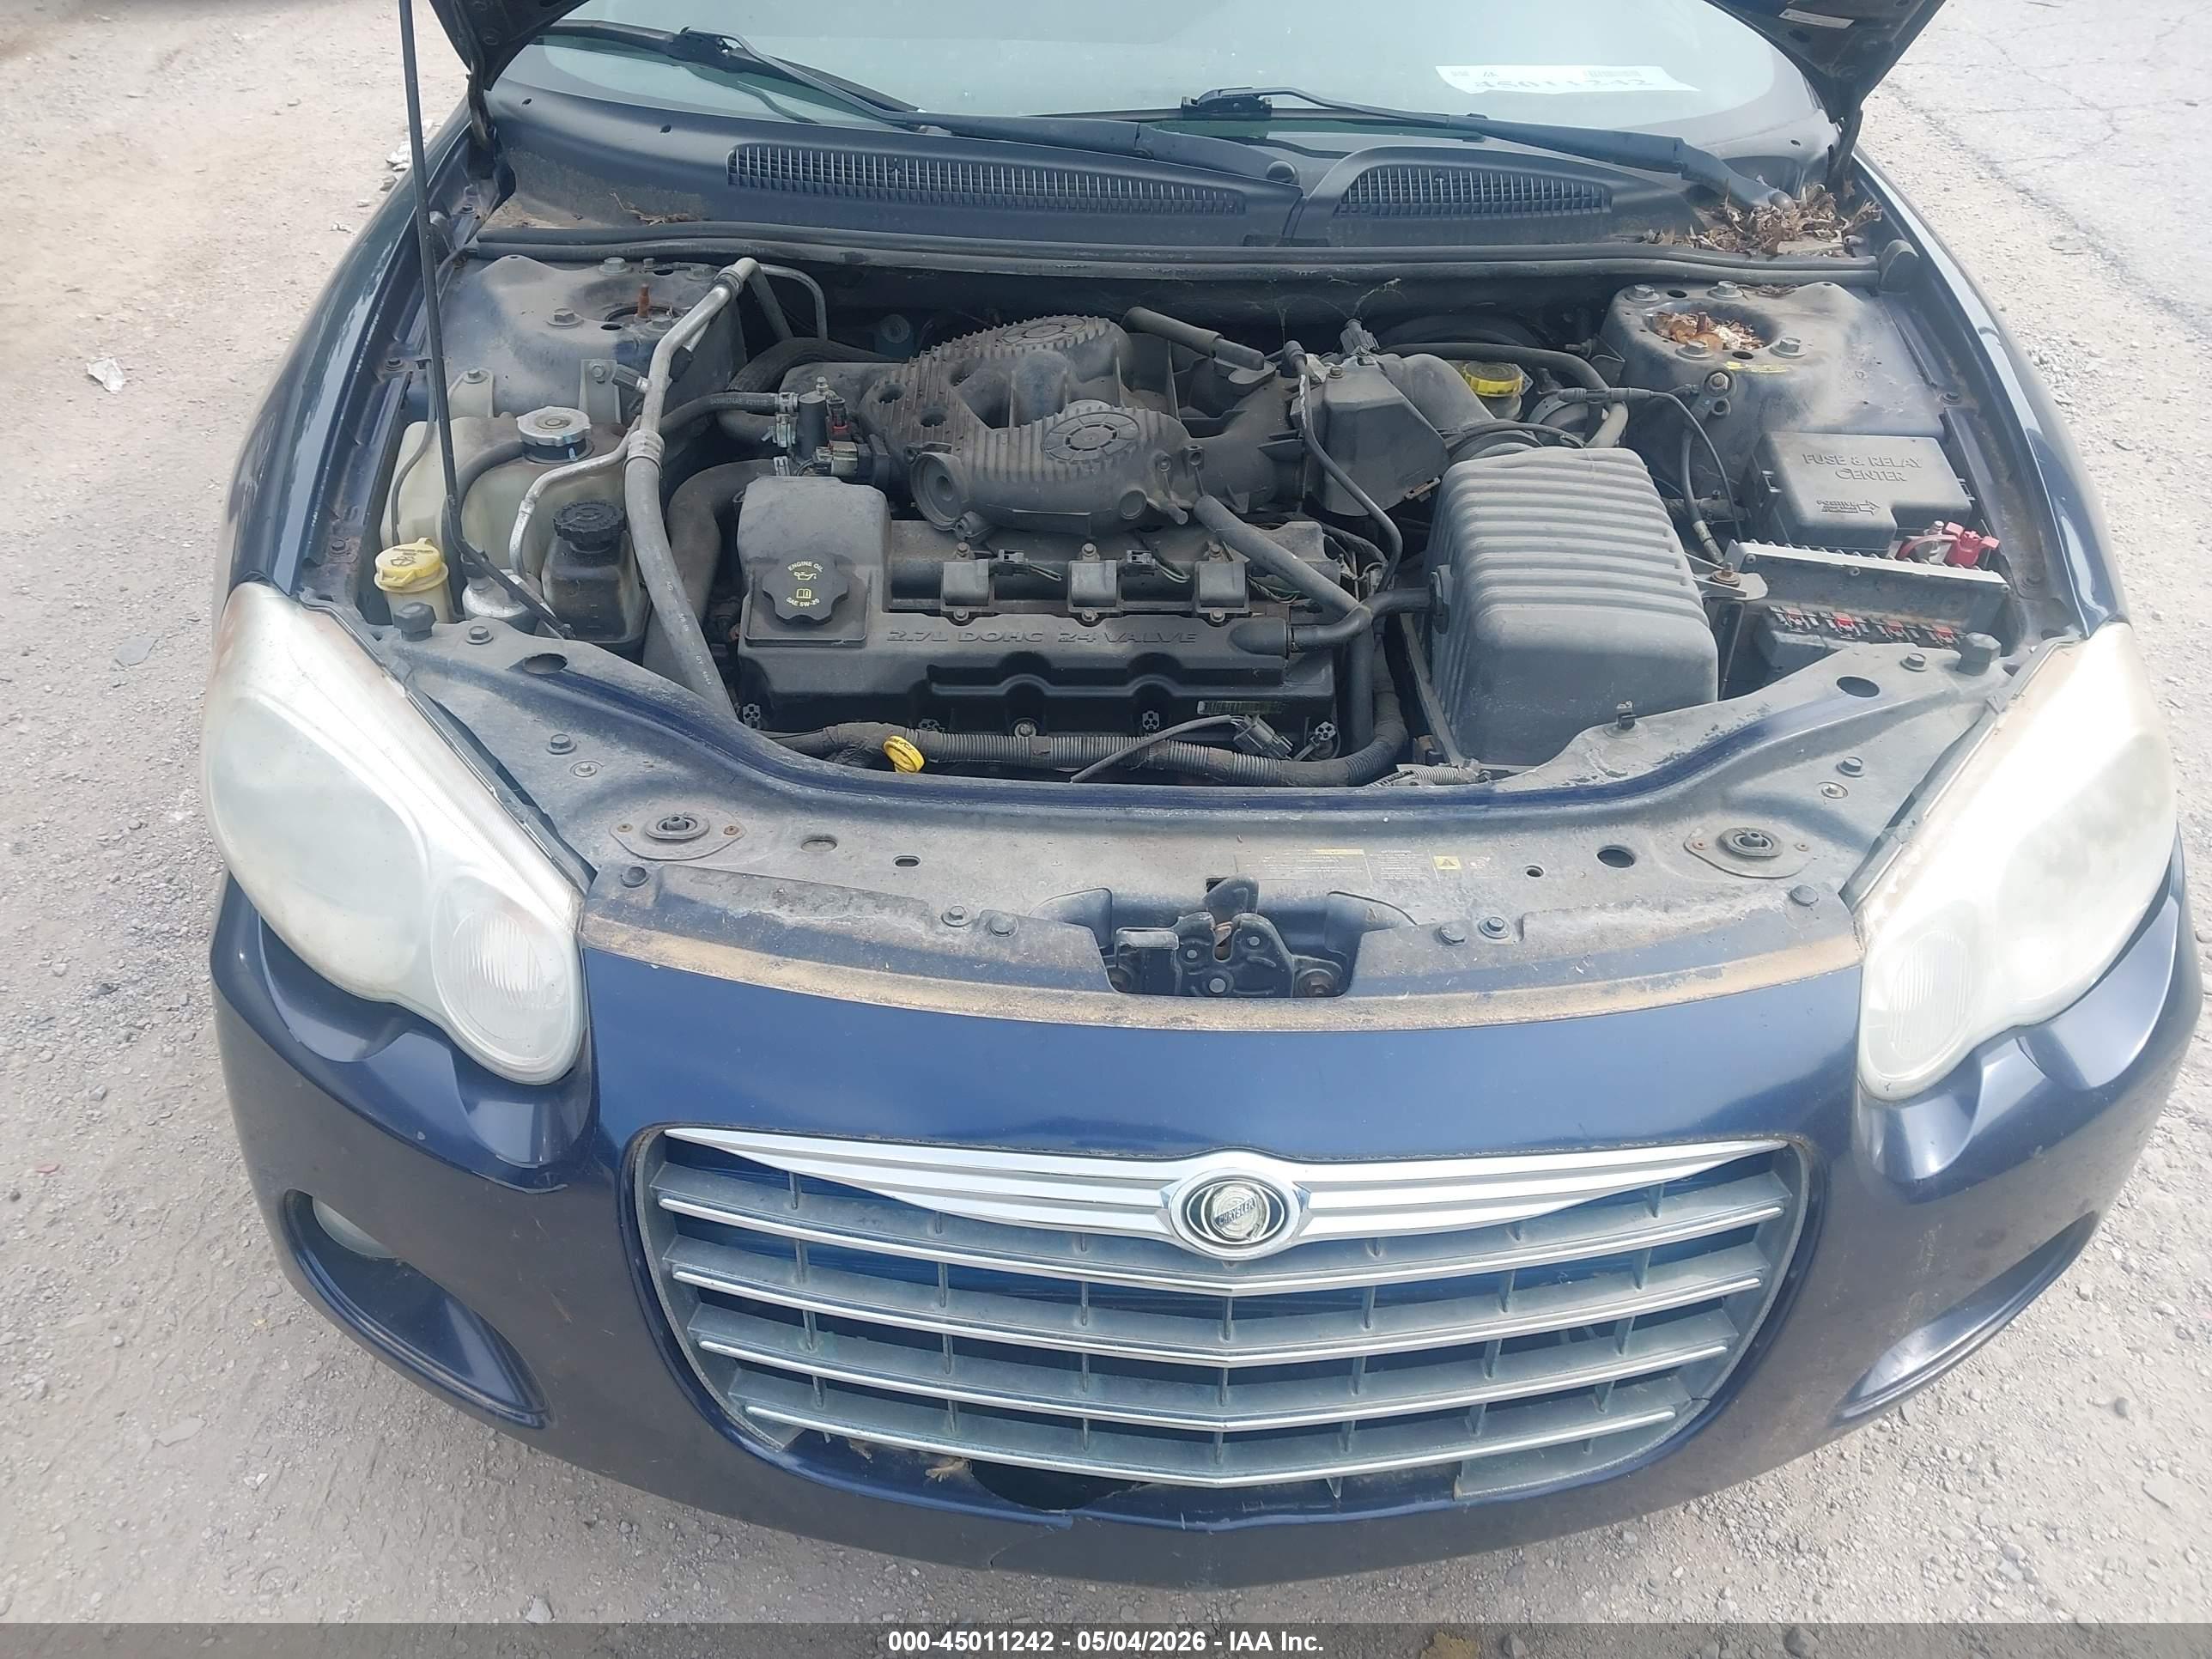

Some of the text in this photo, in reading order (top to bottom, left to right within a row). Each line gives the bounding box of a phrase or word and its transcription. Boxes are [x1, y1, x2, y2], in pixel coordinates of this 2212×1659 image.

[1802, 453, 1923, 469] FUSE & RELAY
[1834, 468, 1907, 482] CENTER
[787, 561, 824, 573] ENGINE OIL
[786, 597, 799, 606] SAE
[885, 630, 949, 644] 2.7L
[957, 631, 1044, 644] DOHC
[1103, 631, 1198, 644] VALVE
[1218, 1196, 1257, 1226] CHRYSLER
